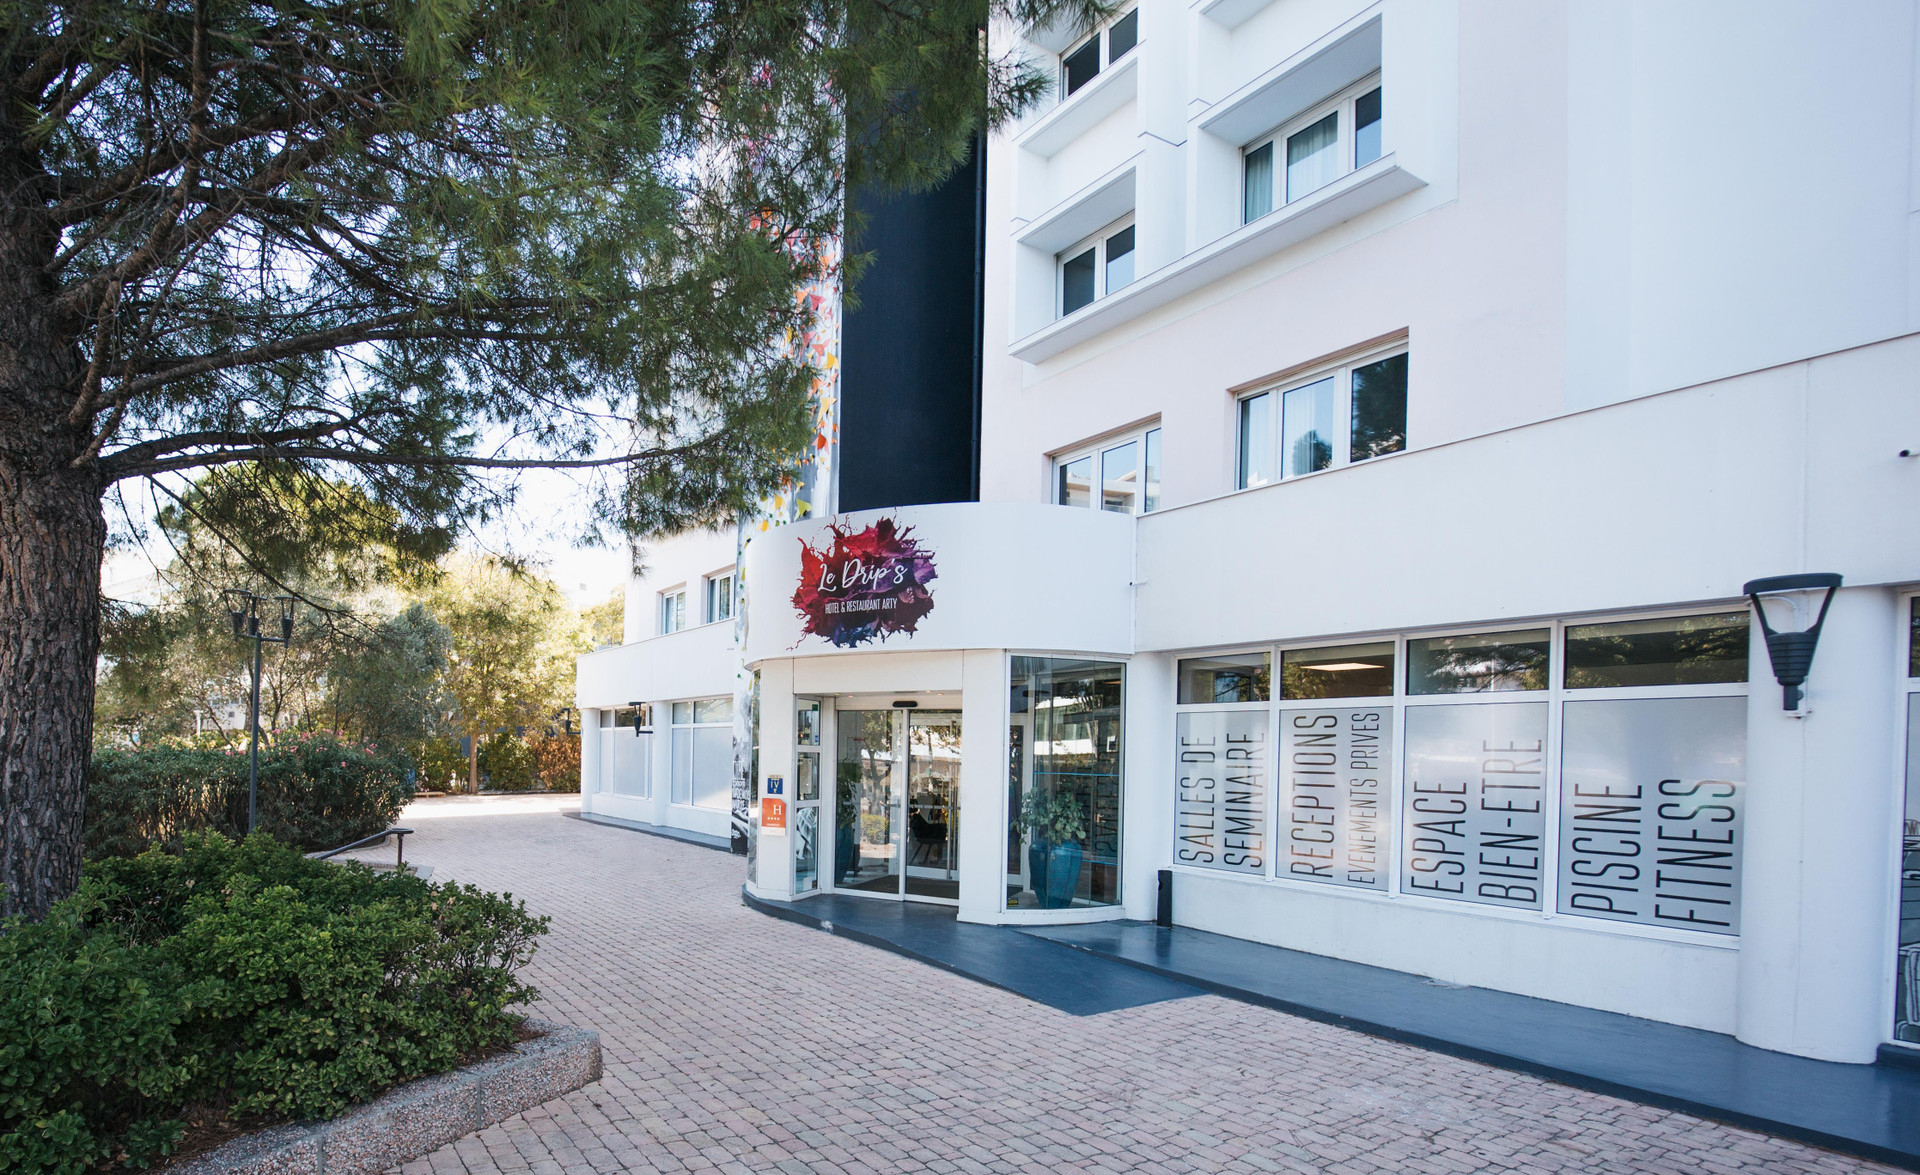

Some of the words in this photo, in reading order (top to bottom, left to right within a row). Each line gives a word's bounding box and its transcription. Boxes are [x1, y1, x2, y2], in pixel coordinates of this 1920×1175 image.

[818, 563, 837, 592] Le
[842, 558, 908, 590] Drip's
[840, 602, 846, 612] &
[846, 599, 881, 612] RESTAURANT
[881, 598, 898, 609] ARTY
[1181, 736, 1216, 763] DE
[1350, 713, 1380, 770] PRIVES
[773, 804, 782, 815] H
[1178, 777, 1216, 863] SALLES
[1223, 733, 1265, 868] SEMINAIRE
[1290, 715, 1338, 878] RECEPTIONS
[1347, 778, 1378, 884] EVENEMENTS
[1411, 780, 1467, 894] ESPACE
[1478, 739, 1542, 903] BIEN-ETRE
[1570, 783, 1642, 915] PISCINE
[1655, 779, 1736, 927] FITNESS
